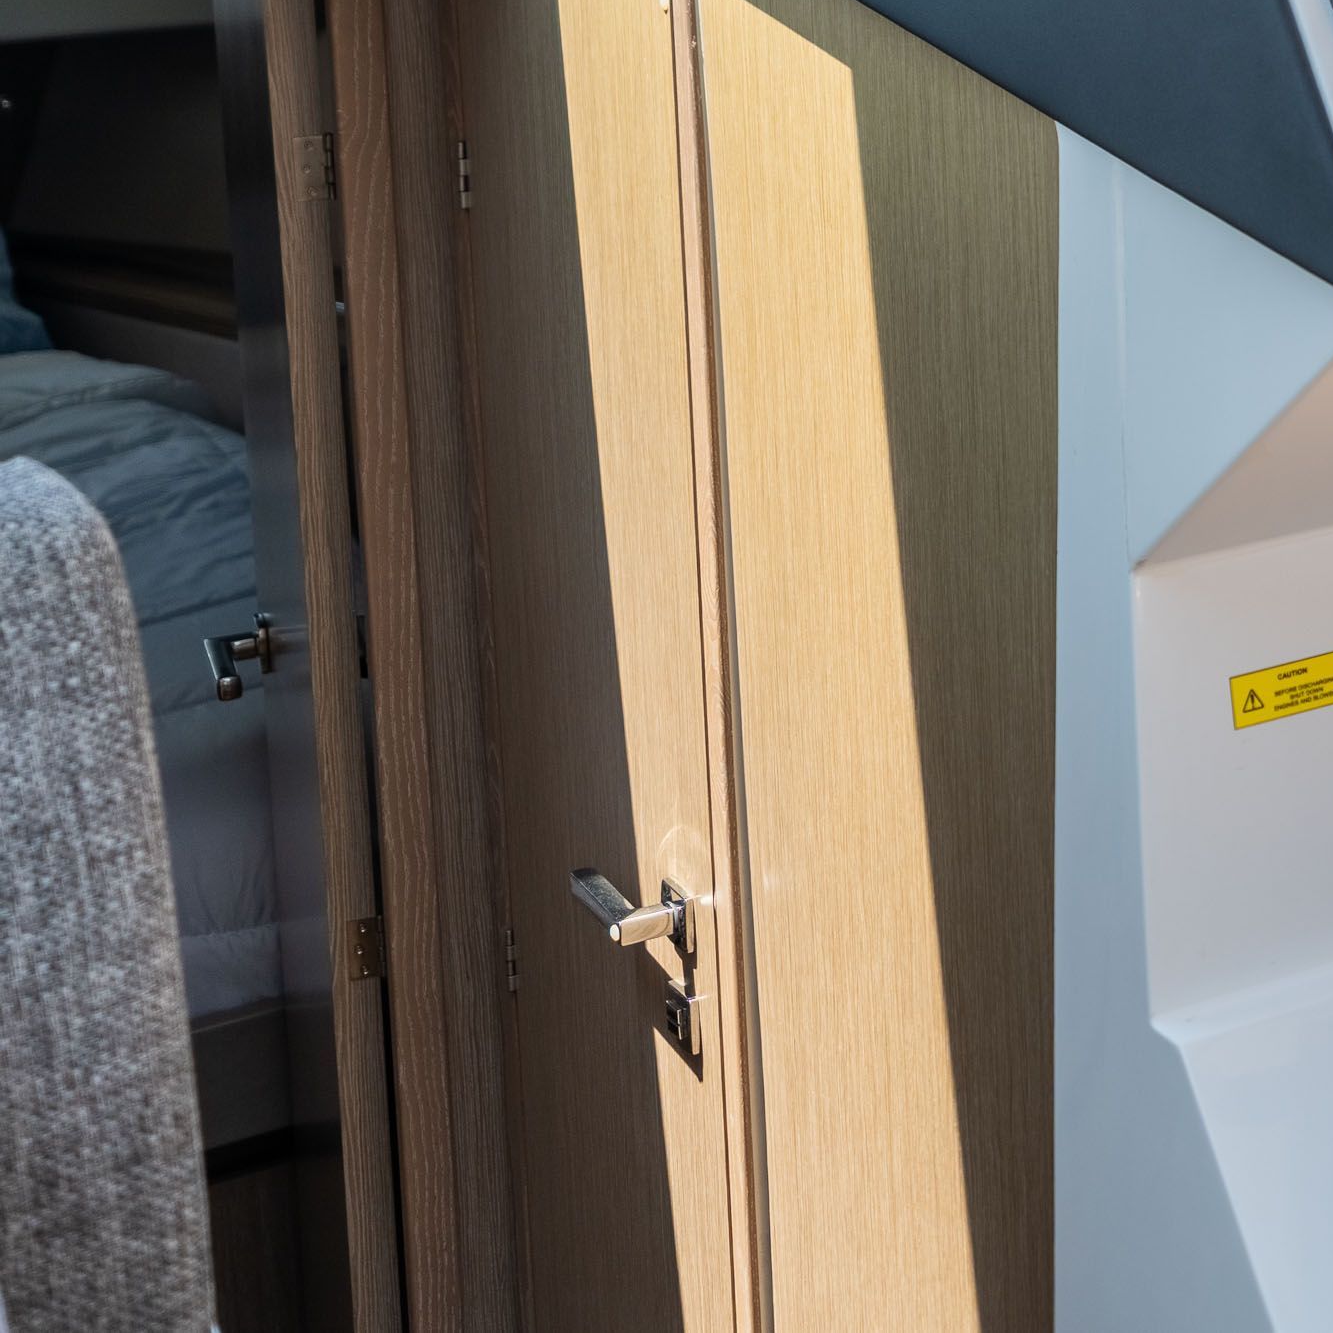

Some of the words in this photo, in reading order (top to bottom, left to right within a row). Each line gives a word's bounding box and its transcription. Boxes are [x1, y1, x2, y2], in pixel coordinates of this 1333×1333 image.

[1277, 667, 1308, 681] CAUTION
[1274, 685, 1297, 697] BEFORE
[1289, 691, 1306, 700] SHUT
[1306, 687, 1324, 696] DOWN
[1274, 701, 1299, 712] ENGINES
[1300, 697, 1312, 705] AND
